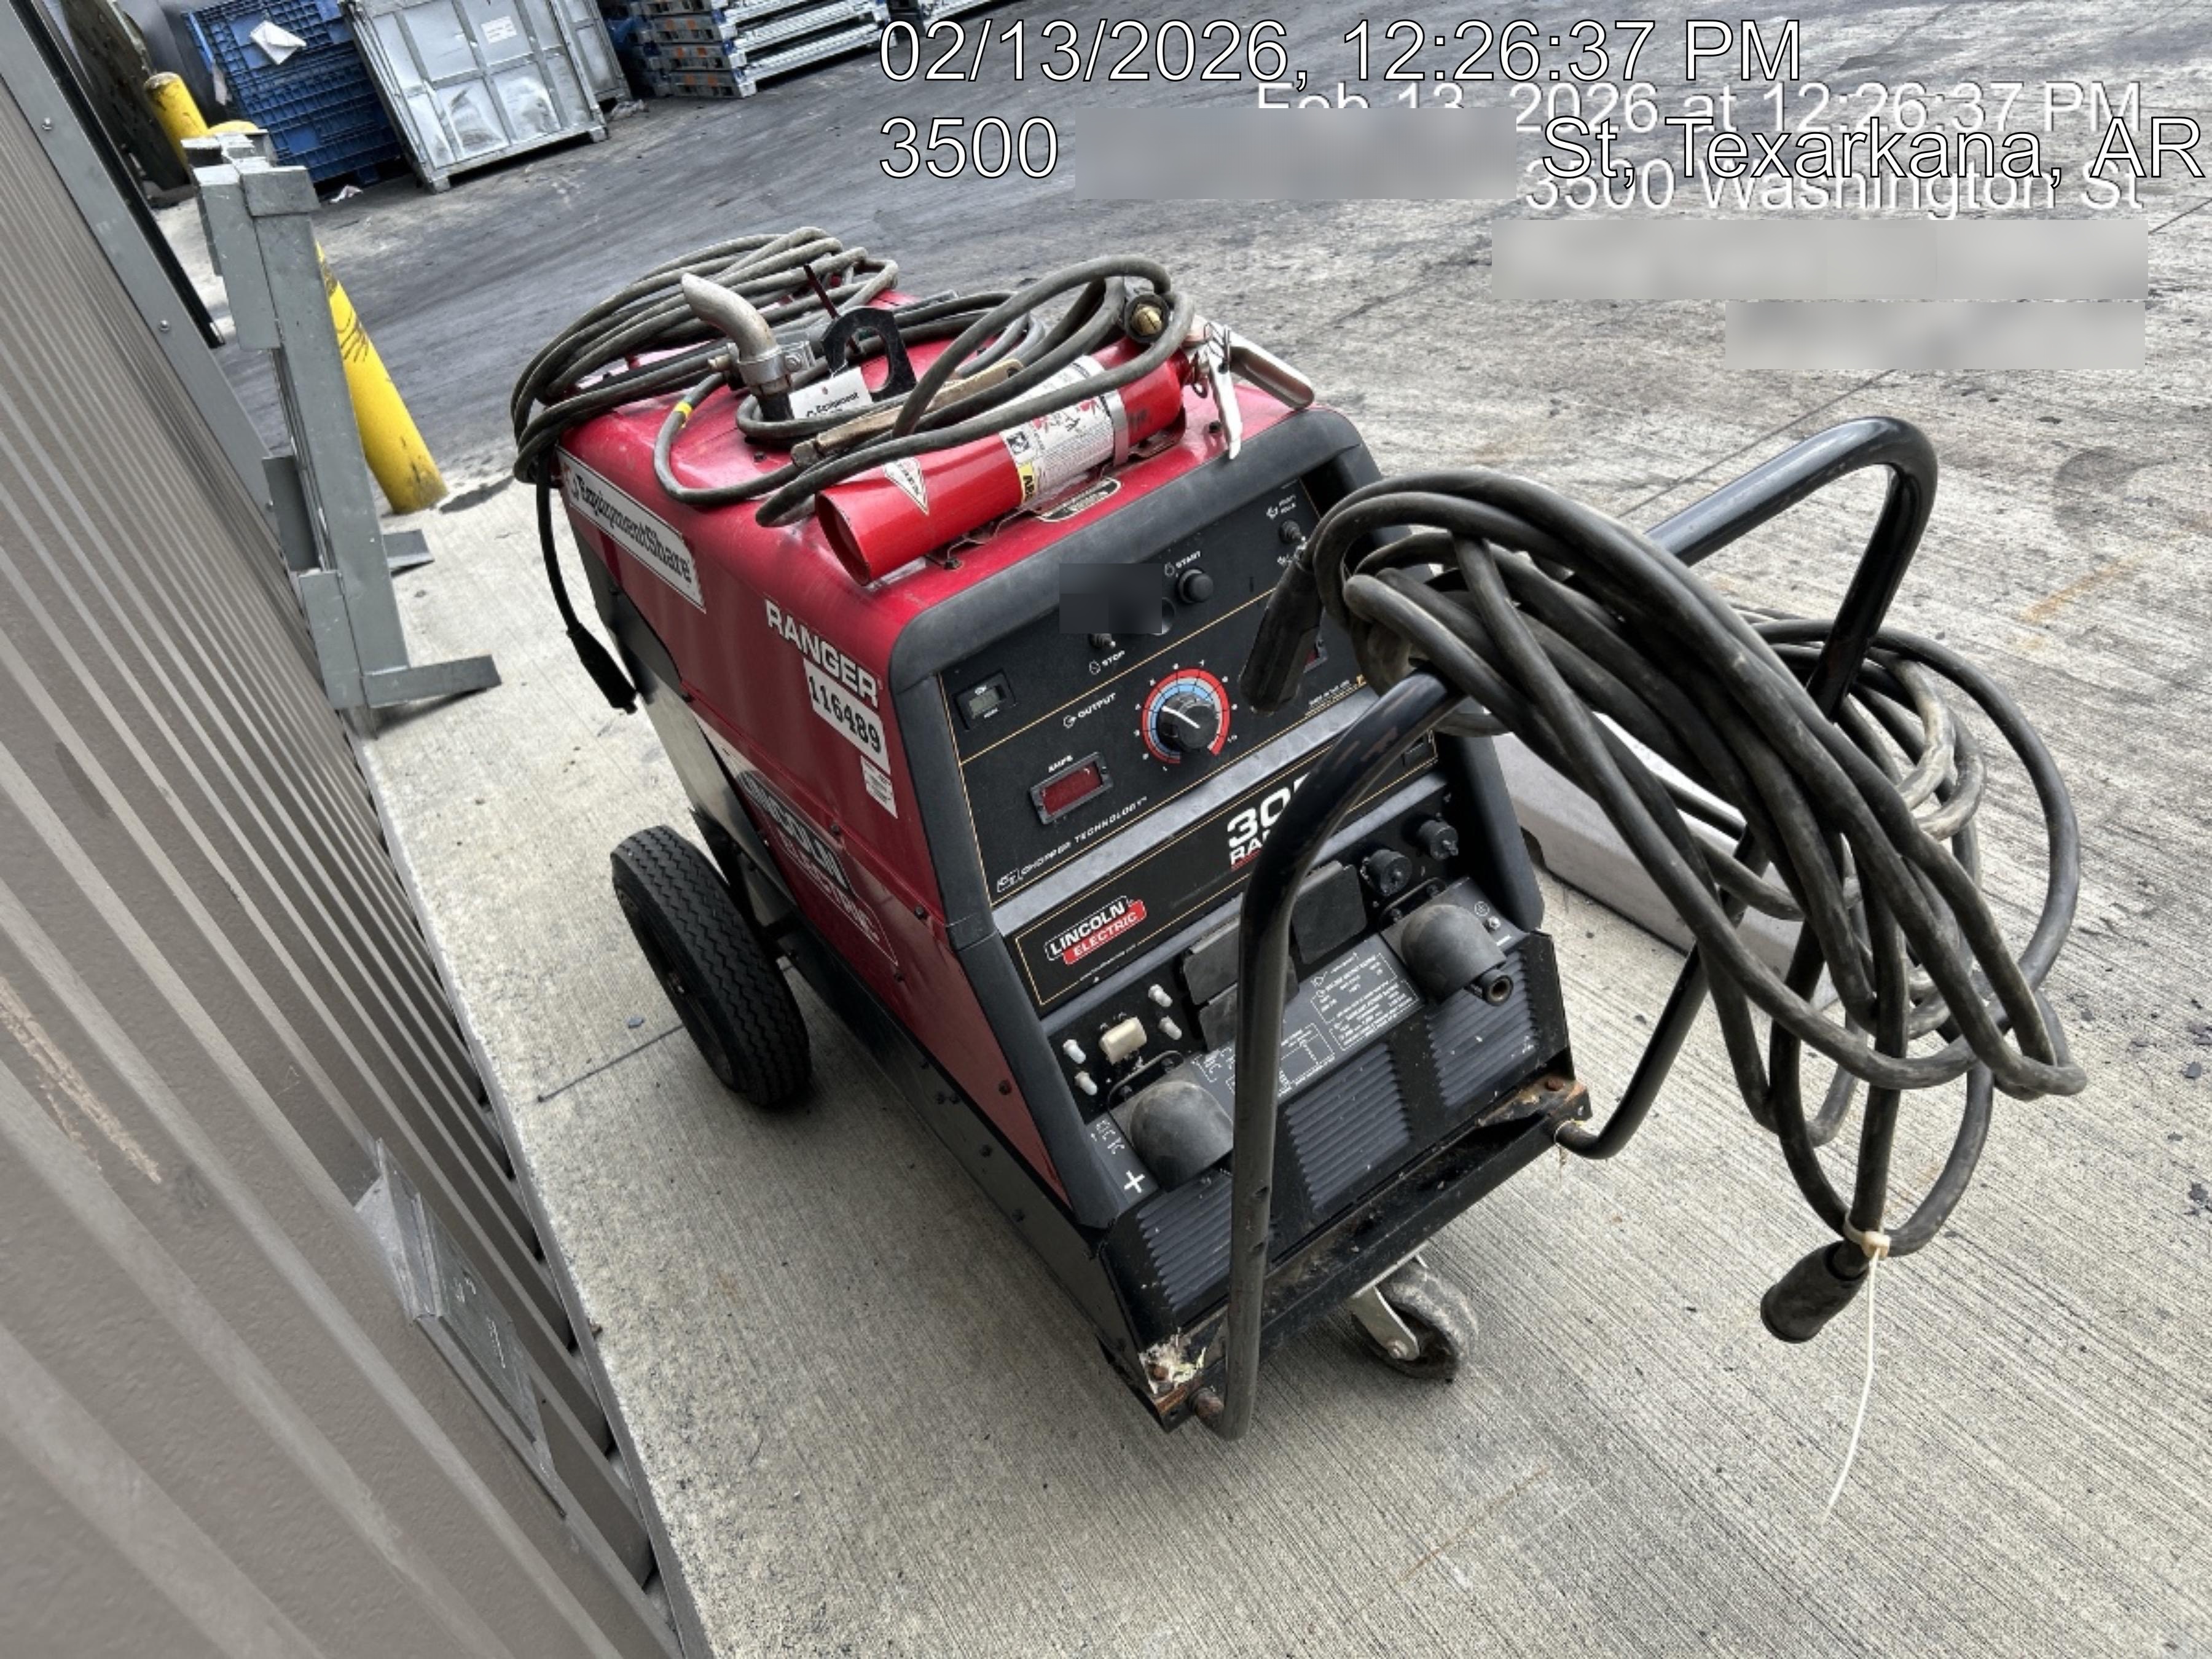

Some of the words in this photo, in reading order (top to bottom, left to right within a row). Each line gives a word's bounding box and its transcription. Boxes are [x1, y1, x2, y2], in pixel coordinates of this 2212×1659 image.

[1175, 550, 1201, 569] START
[764, 598, 879, 709] RANGER
[807, 675, 882, 754] 116489
[1078, 692, 1116, 718] OUTPUT
[1048, 755, 1073, 774] AMPS
[1227, 771, 1312, 848] 30
[1049, 900, 1126, 955] LINCOLN
[1073, 911, 1138, 955] ELECTRIC
